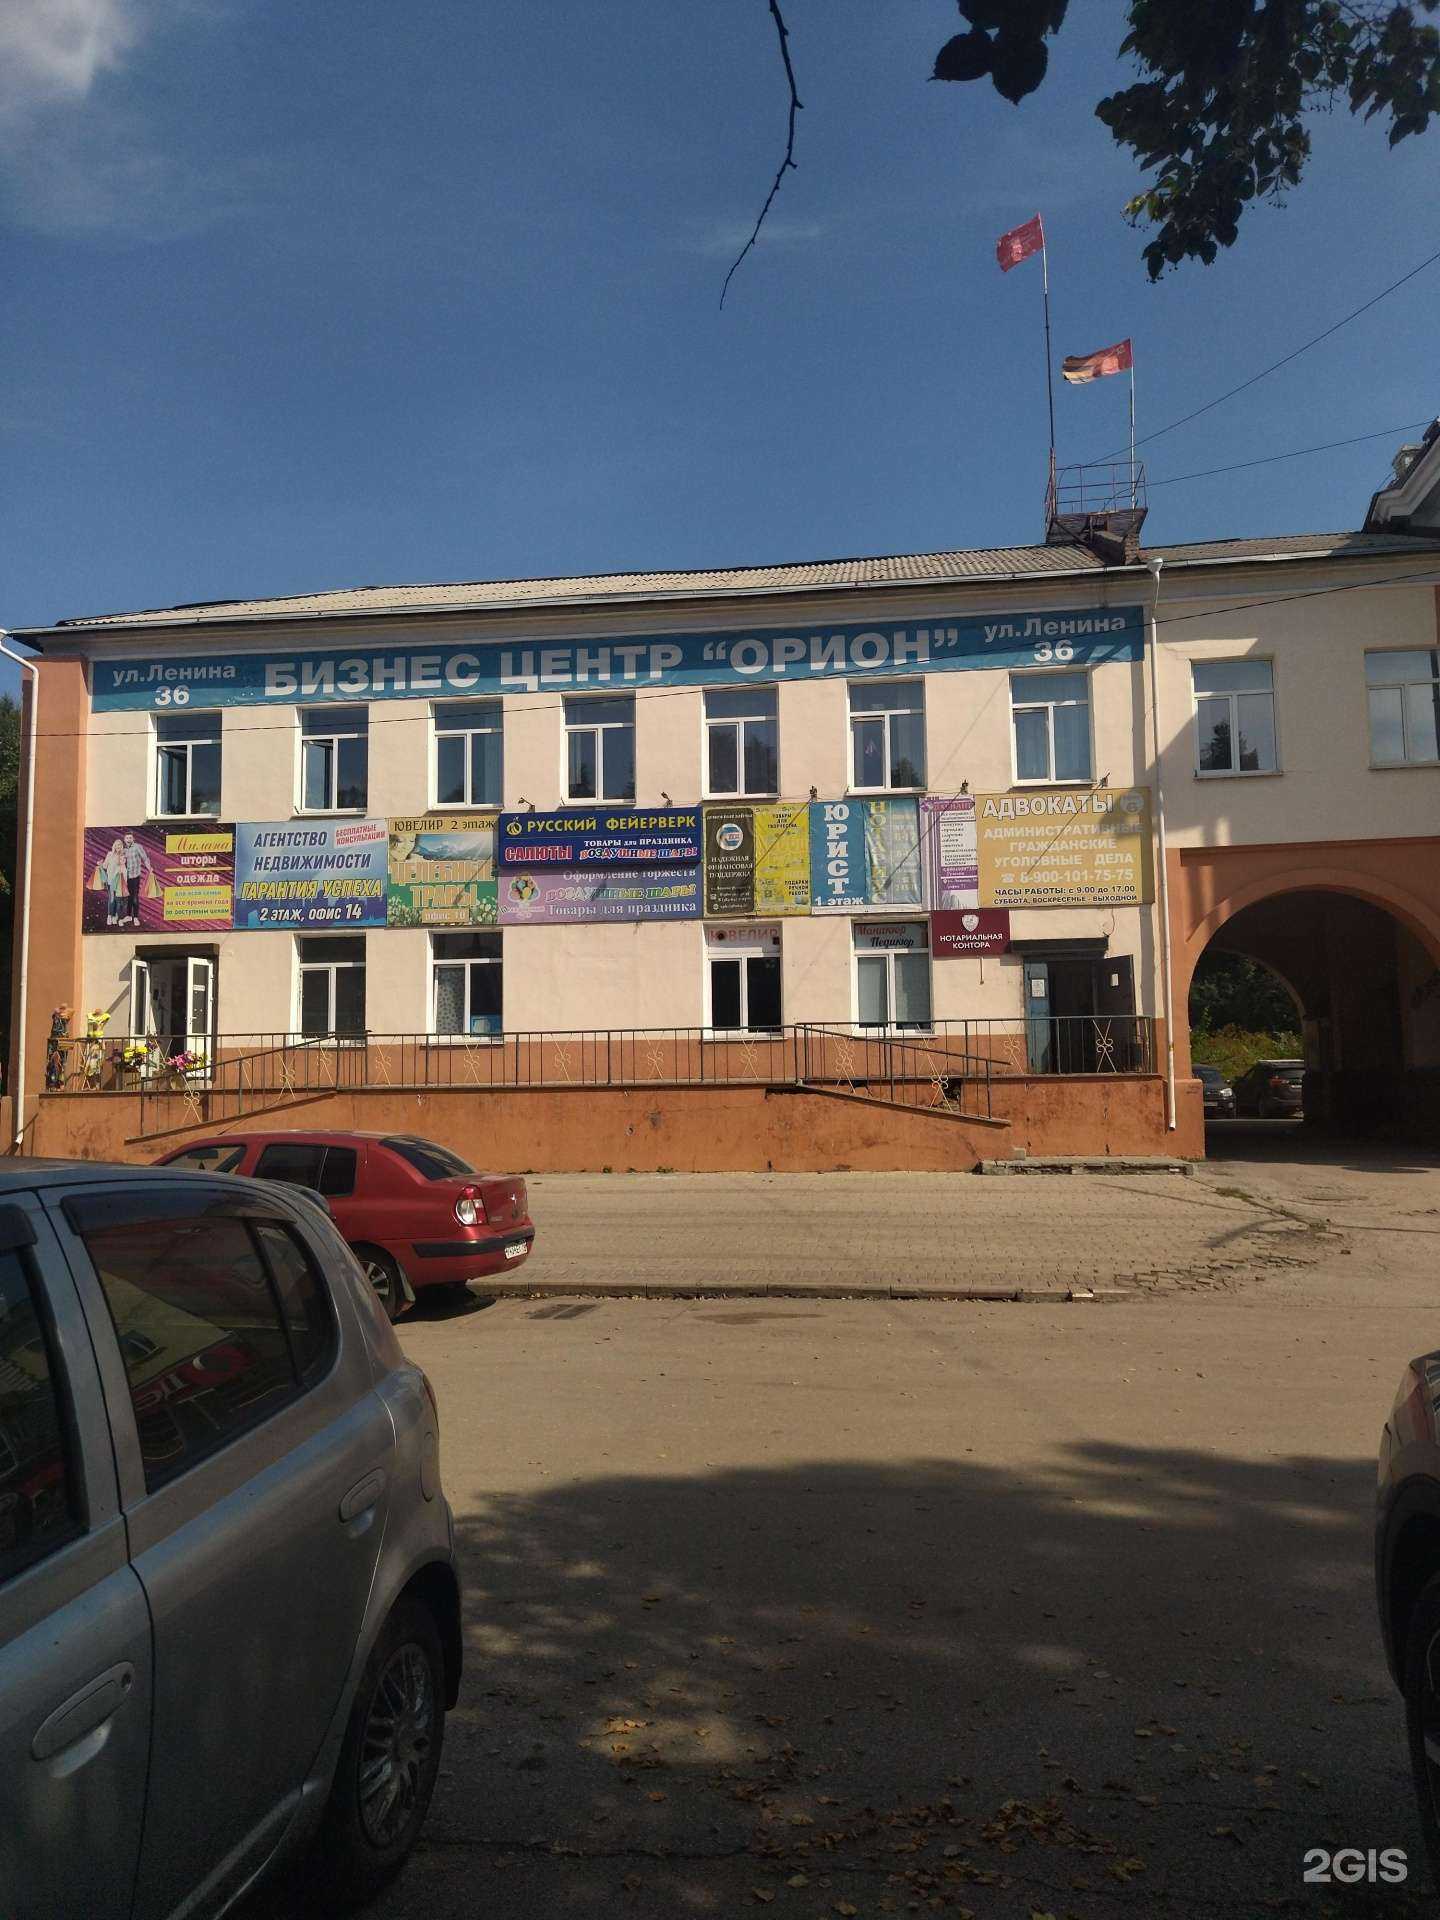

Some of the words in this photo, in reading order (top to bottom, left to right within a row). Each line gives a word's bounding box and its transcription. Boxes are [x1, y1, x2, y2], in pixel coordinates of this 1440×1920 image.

[1033, 639, 1074, 662] 36
[264, 653, 481, 697] БИЗНЕС
[500, 643, 684, 692] ЦЕНТР
[154, 685, 191, 706] 36
[982, 794, 1114, 821] АДВОКАТЫ
[335, 823, 377, 837] БЕСПЛАТНЫЕ
[394, 819, 443, 831] ЮВЕЛИР
[450, 820, 458, 830] 2
[527, 817, 597, 833] РУССКИЙ
[605, 815, 697, 831] ФЕЙЕРВЕРК
[984, 822, 1144, 840] АДМИНИСТРАТИВНЫЕ
[254, 831, 328, 848] АГЕНТСТВО
[336, 830, 386, 846] КОНСУЛЬТАЦИИ
[583, 839, 621, 847] ТОВАРЫ
[639, 837, 693, 846] ПРАЗДНИКА
[1010, 838, 1118, 852] ГРАЖДАНСКИЕ
[505, 845, 574, 862] САЛЮТЫ
[579, 848, 657, 860] ВОЗДУШНЫЕ
[823, 803, 850, 895] ЮРИСТ
[181, 855, 217, 866] шторы
[253, 853, 372, 872] НЕДВИЖИМОСТИ
[708, 862, 753, 871] ФИНАНСОВАЯ
[994, 855, 1083, 868] УГОЛОВНЫЕ
[1094, 852, 1135, 866] ДЕЛА
[563, 870, 639, 883] Оформление
[642, 868, 697, 880] торжеств
[709, 871, 751, 879] ПОДДЕРЖКА
[241, 880, 318, 900] ГАРАНТИЯ
[322, 878, 383, 898] УСПЕХА
[409, 885, 478, 907] ТРАВЫ
[995, 888, 1022, 896] ЧАСЫ
[1025, 886, 1066, 895] РАБОТЫ:
[1112, 885, 1135, 893] 17.00
[815, 896, 822, 906] 1
[827, 896, 864, 906] этаж
[1093, 894, 1137, 902] ВЫХОДНОЙ
[259, 908, 269, 921] 2
[270, 909, 305, 922] ЭТАЖ,
[308, 908, 342, 920] ОФИС
[345, 903, 362, 919] 14
[549, 904, 597, 917] Товары
[600, 904, 624, 915] для
[627, 900, 697, 915] праздника
[870, 936, 915, 949] Педикюр
[940, 933, 1003, 942] НОТАРИАЛЬНАЯ
[952, 941, 991, 949] КОНТОРА
